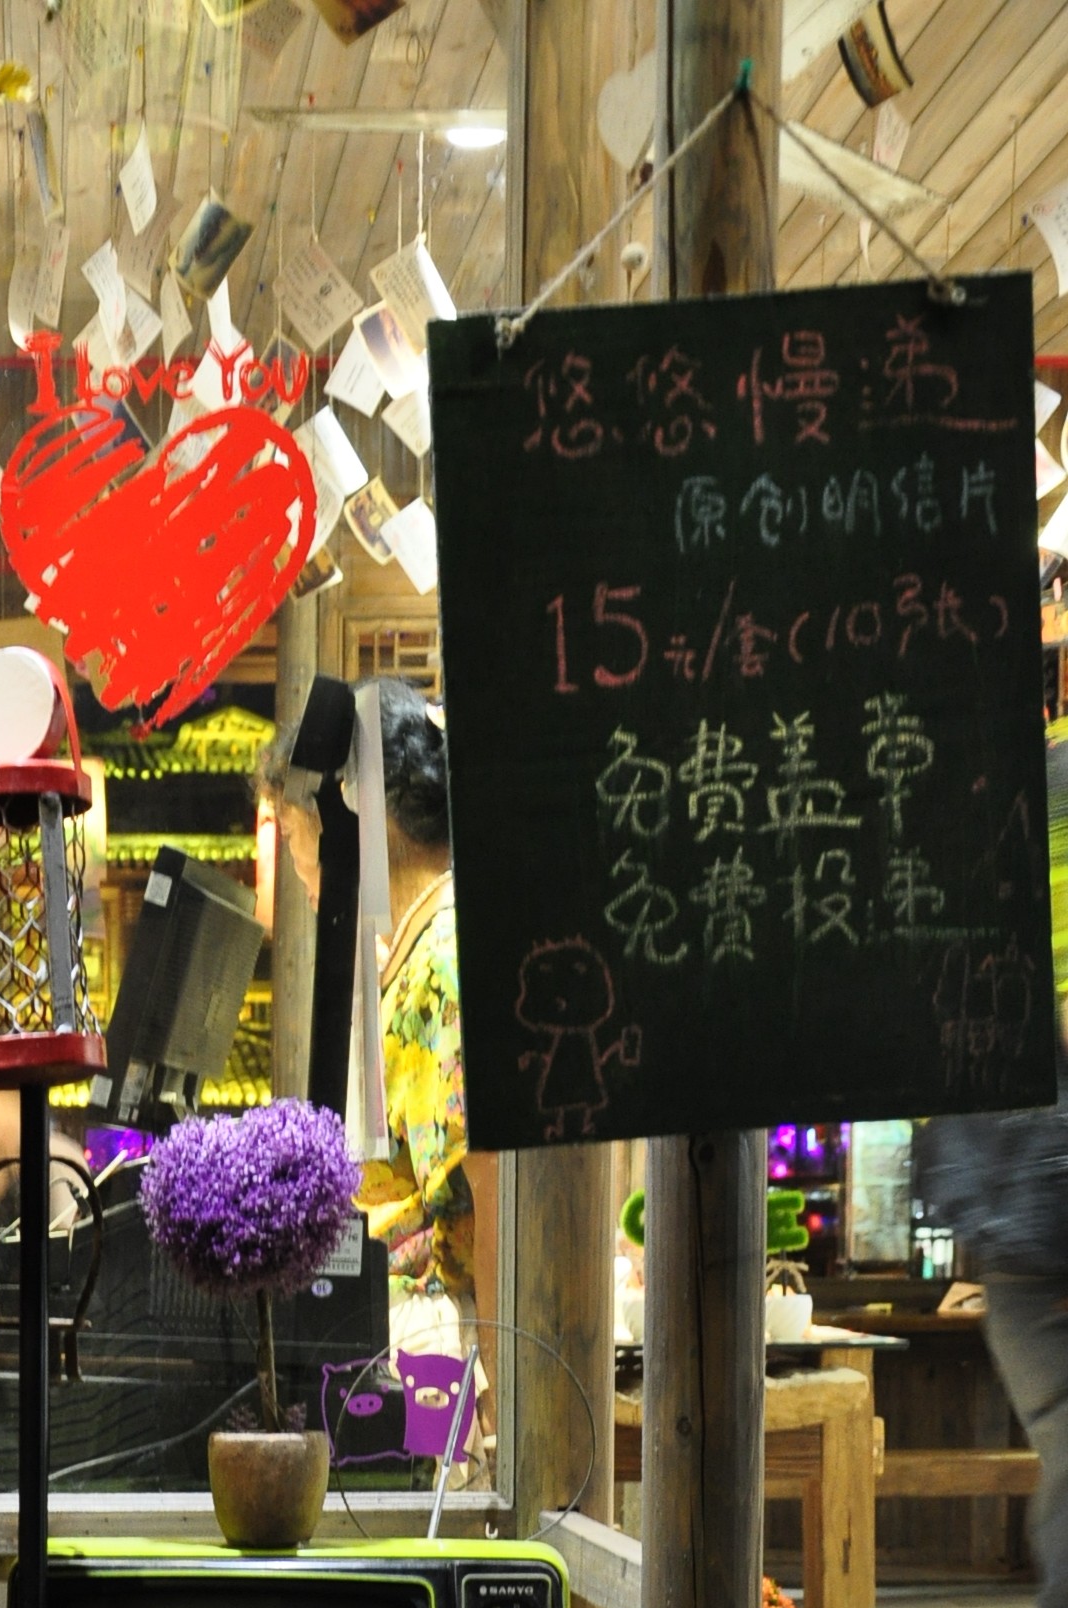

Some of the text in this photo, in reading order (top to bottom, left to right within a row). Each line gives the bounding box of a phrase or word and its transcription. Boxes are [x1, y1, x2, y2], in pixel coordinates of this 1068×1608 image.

[24, 330, 309, 412] I Love You
[489, 1586, 534, 1595] SANYO
